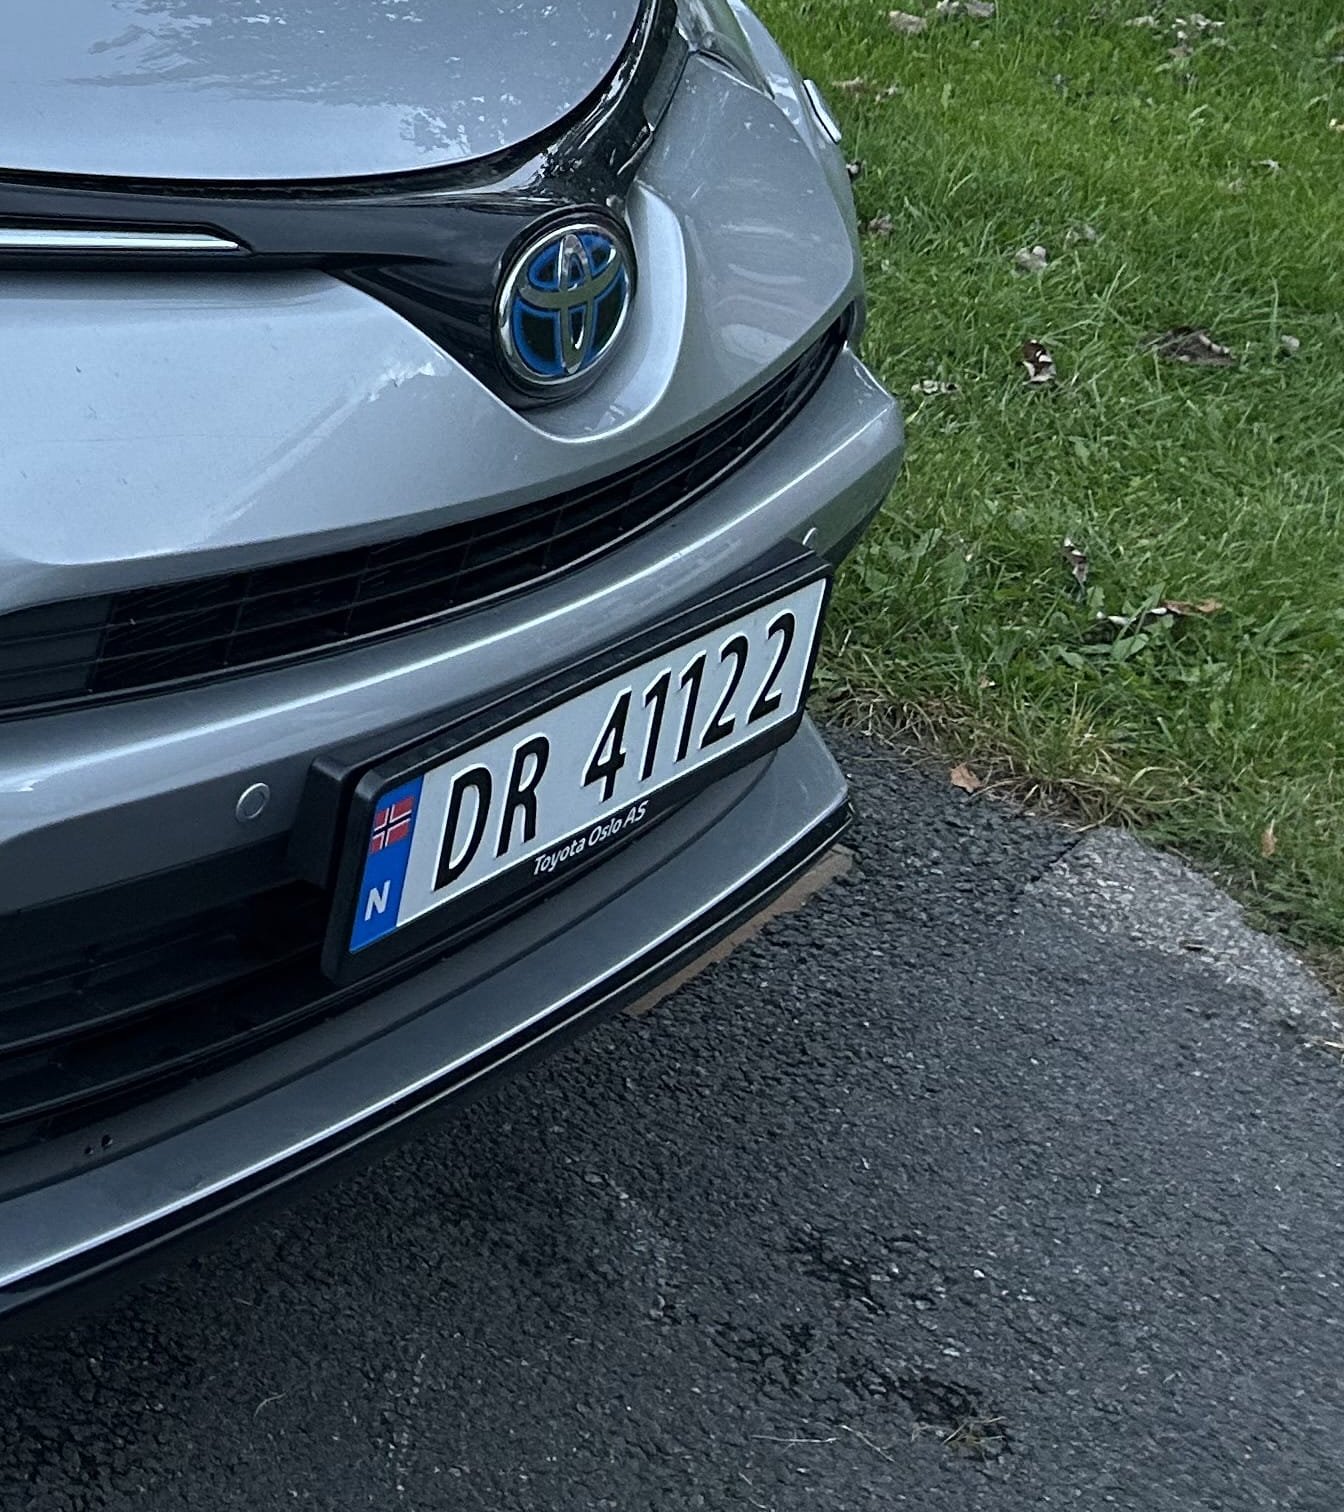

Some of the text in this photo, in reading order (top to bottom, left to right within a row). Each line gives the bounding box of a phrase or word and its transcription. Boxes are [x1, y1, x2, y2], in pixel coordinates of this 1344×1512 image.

[432, 610, 796, 892] DR 41122
[532, 800, 649, 876] Toyota Oslo AS
[364, 879, 390, 921] N
